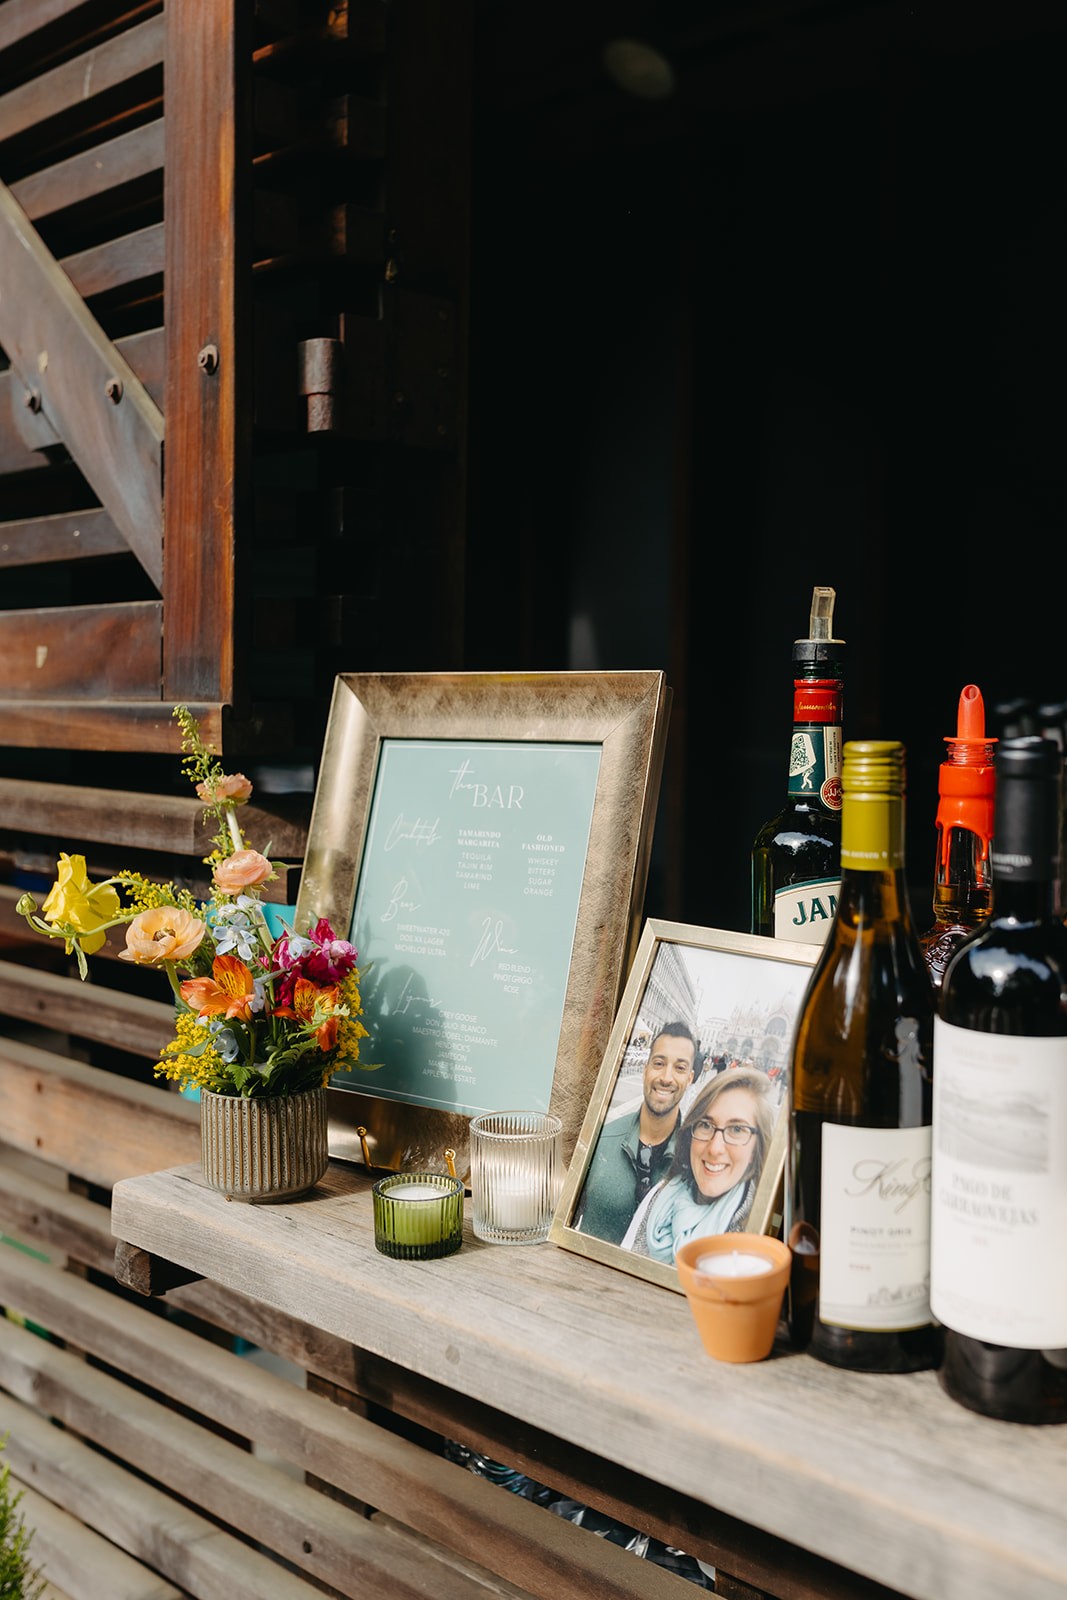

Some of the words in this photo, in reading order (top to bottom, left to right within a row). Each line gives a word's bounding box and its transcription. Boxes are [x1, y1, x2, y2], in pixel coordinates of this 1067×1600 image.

[448, 759, 476, 799] the
[472, 784, 524, 809] BAR
[458, 830, 501, 839] TAMARINDO
[536, 834, 553, 842] OLD
[457, 838, 500, 848] MARGARITA
[521, 843, 565, 852] FASHIONED
[462, 852, 491, 861] TEQUILA
[528, 857, 559, 865] WHISKEY
[456, 871, 492, 880] TAMARIND
[528, 867, 555, 876] BITTERS
[464, 881, 480, 890] LIME
[528, 877, 552, 886] SUGAR
[524, 887, 553, 896] ORANGE
[424, 936, 444, 946] LAGER
[470, 916, 518, 967] Wine
[499, 963, 510, 971] RED
[511, 964, 531, 974] BLEND
[493, 973, 511, 982] PINOT
[455, 1013, 477, 1023] GOOSE
[412, 1027, 440, 1037] MAESTRO
[460, 1024, 487, 1034] BLANCO
[454, 1063, 473, 1073] MARK
[454, 1075, 476, 1084] ESTATE
